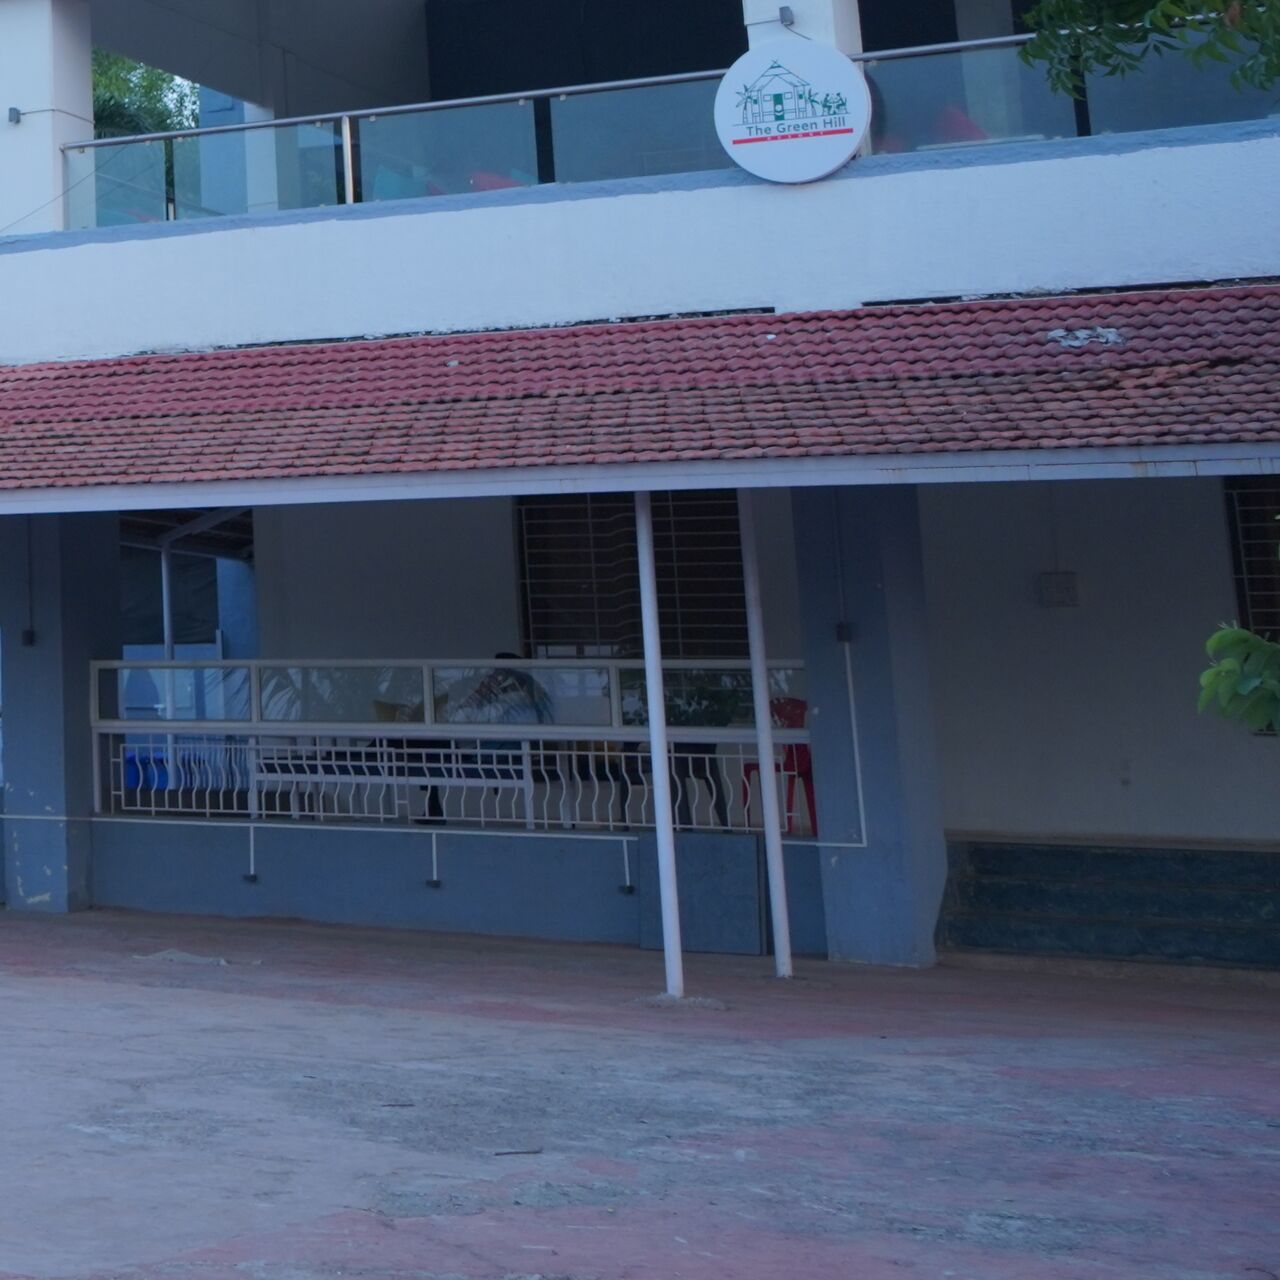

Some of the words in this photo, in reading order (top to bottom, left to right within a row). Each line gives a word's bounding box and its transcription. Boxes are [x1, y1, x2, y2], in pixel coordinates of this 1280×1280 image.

[746, 125, 771, 137] The
[776, 122, 818, 133] Green
[823, 117, 845, 128] Hill
